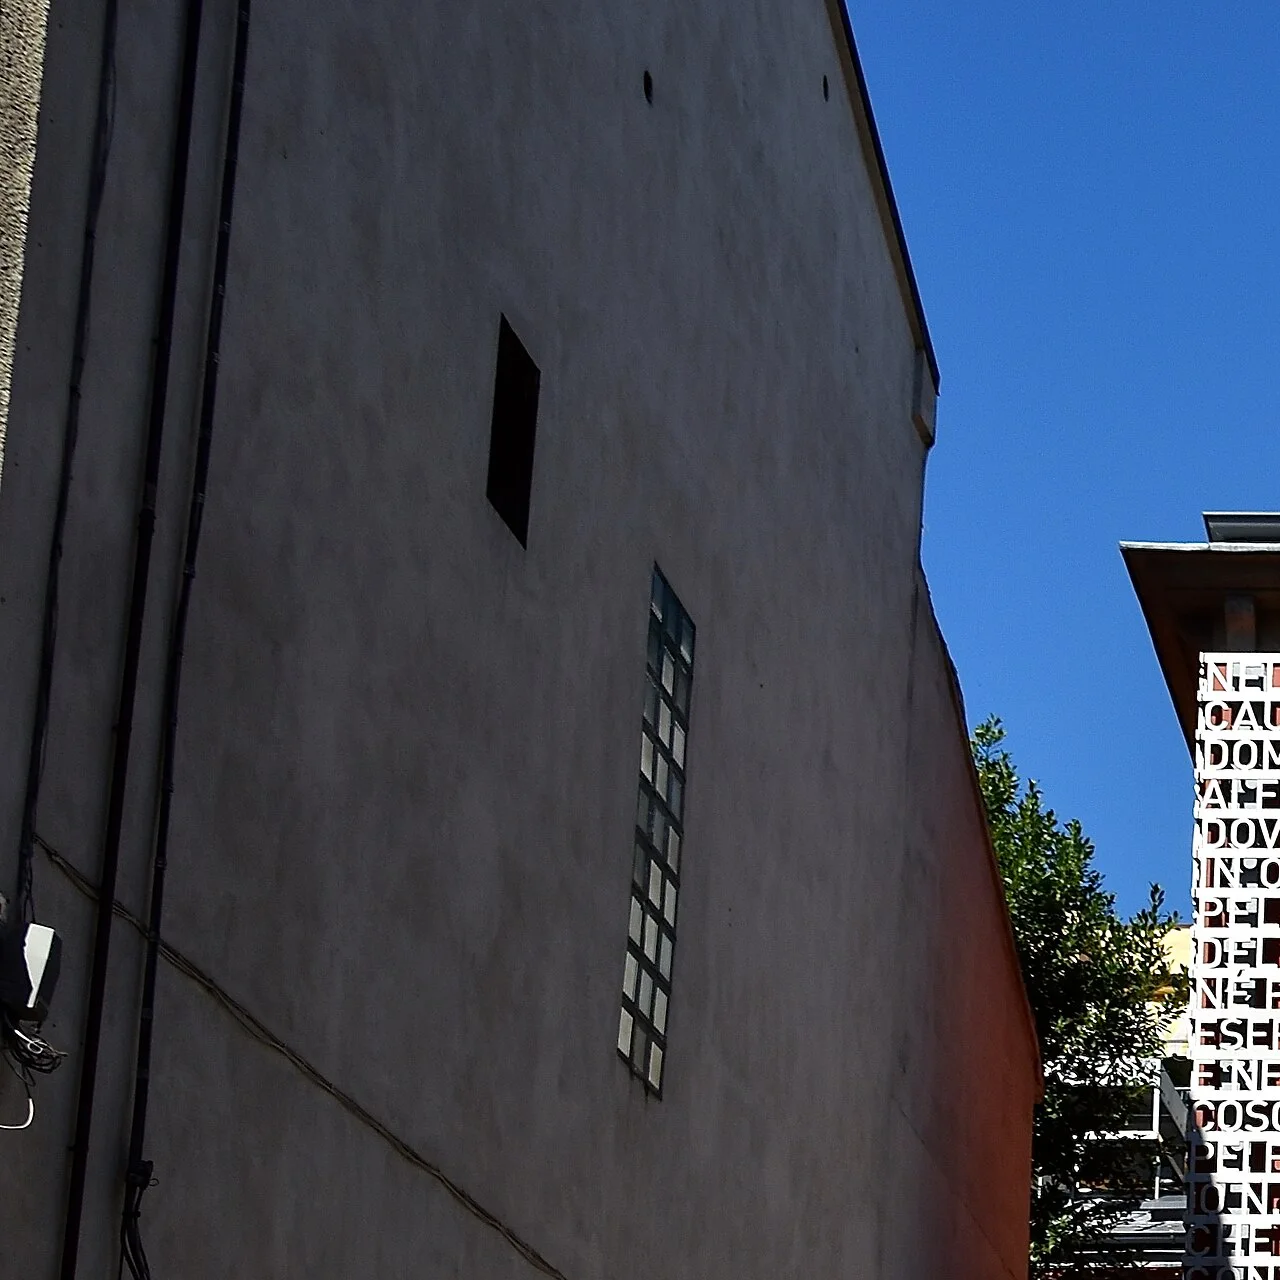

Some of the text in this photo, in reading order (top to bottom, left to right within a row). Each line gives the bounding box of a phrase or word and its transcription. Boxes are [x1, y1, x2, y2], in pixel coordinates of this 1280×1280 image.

[1198, 897, 1278, 930] PEL
[1202, 937, 1277, 969] DEL
[1187, 1223, 1271, 1257] CHE
